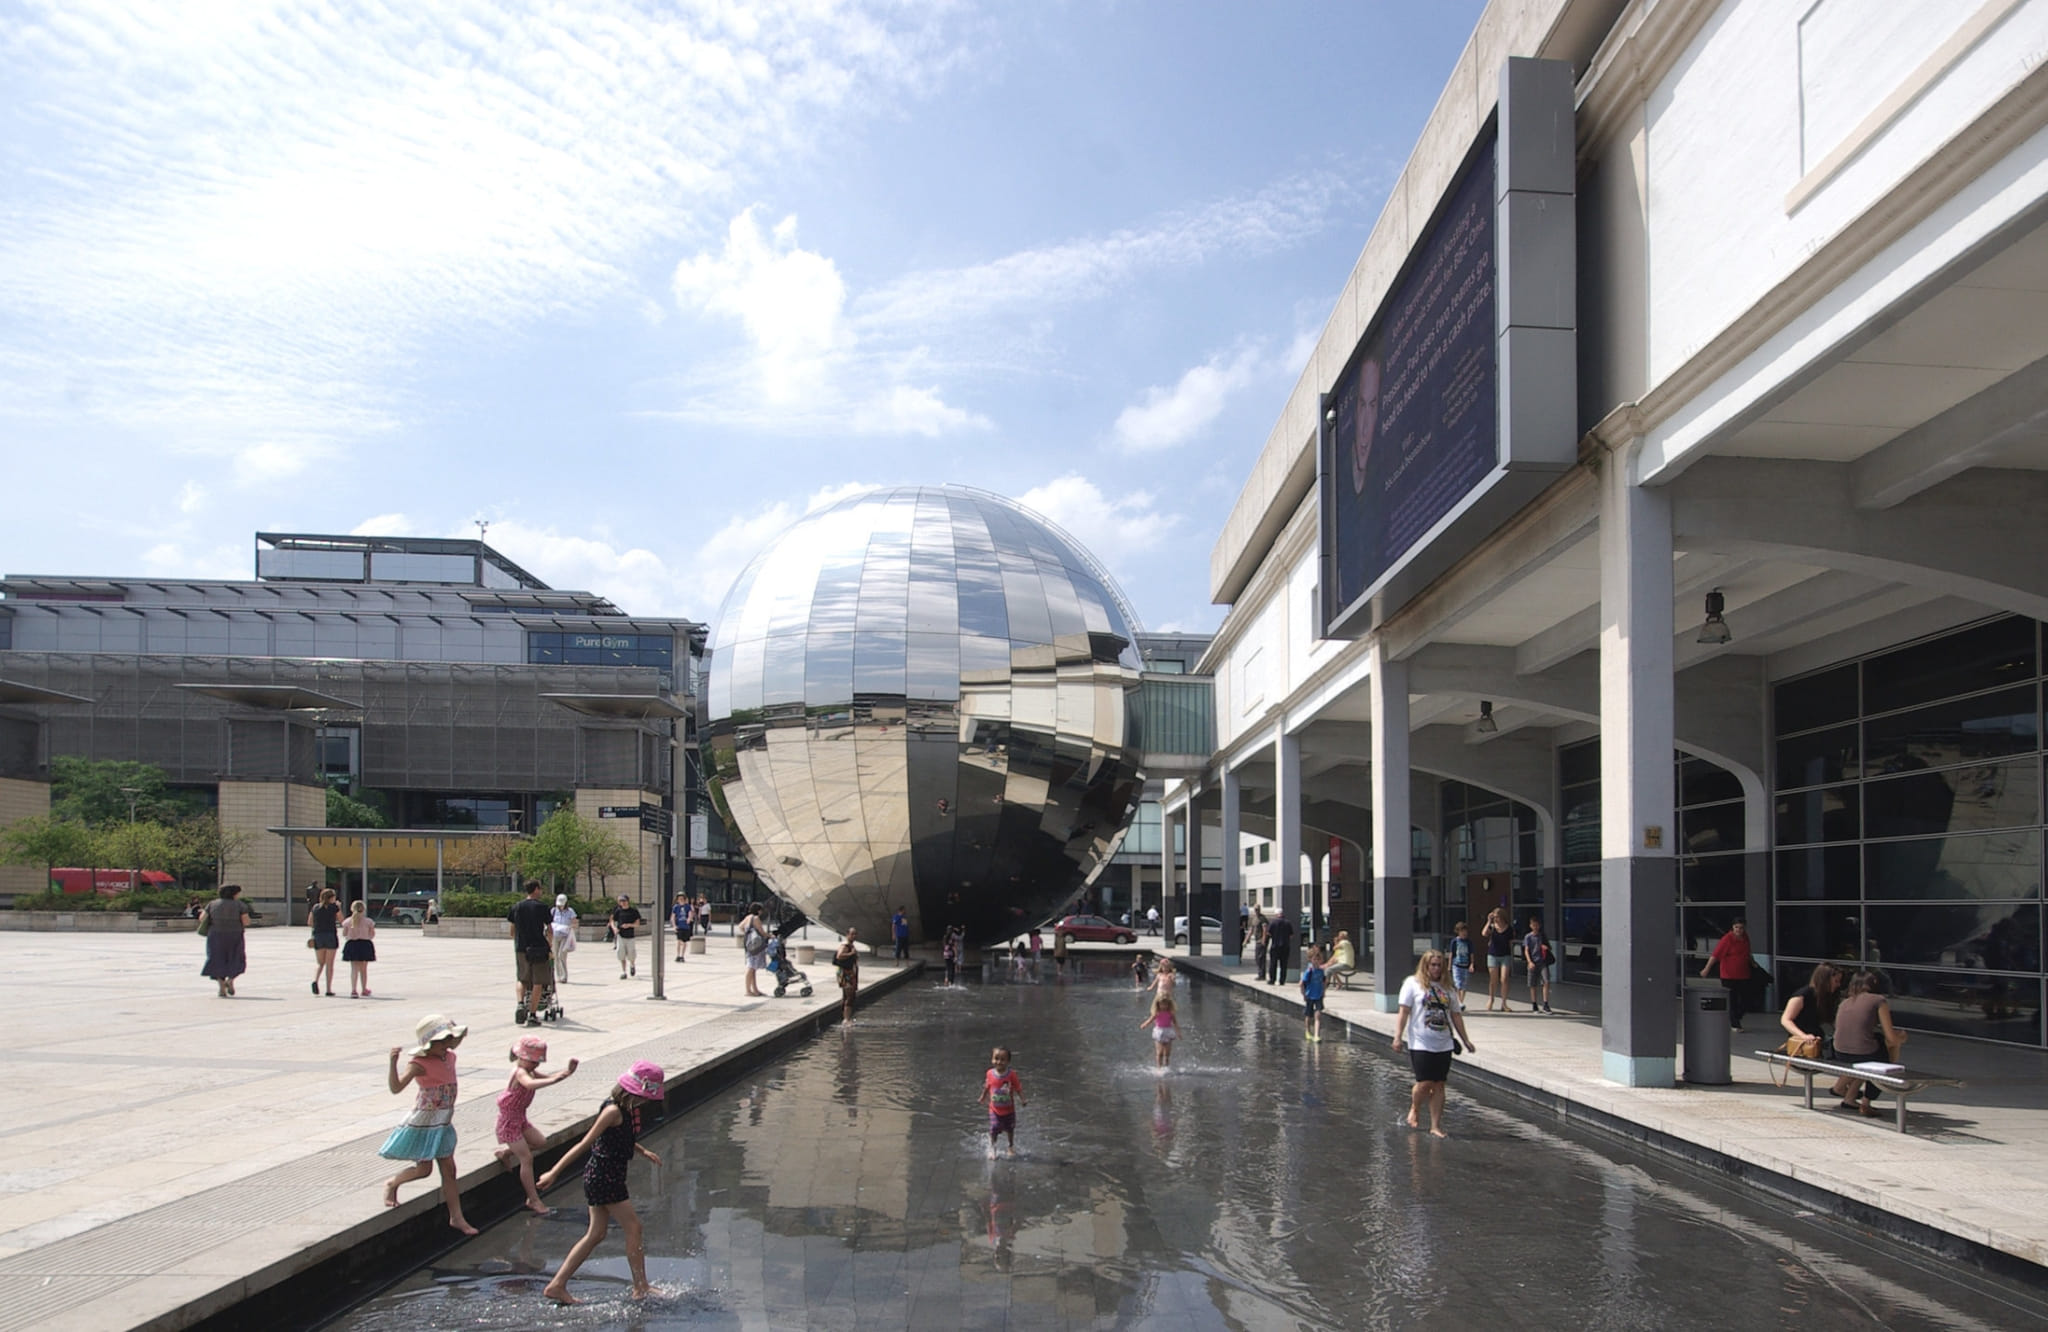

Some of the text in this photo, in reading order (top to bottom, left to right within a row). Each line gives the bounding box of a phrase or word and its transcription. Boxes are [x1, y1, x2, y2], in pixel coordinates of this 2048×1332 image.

[1444, 211, 1469, 258] hosting
[1454, 239, 1467, 270] BBC
[1403, 374, 1419, 406] head
[1448, 309, 1465, 345] cash
[1467, 281, 1491, 325] prize.
[1407, 349, 1418, 375] Pad
[1420, 328, 1435, 356] sees
[1436, 306, 1449, 333] two
[1451, 269, 1475, 312] teams
[1477, 250, 1488, 281] go
